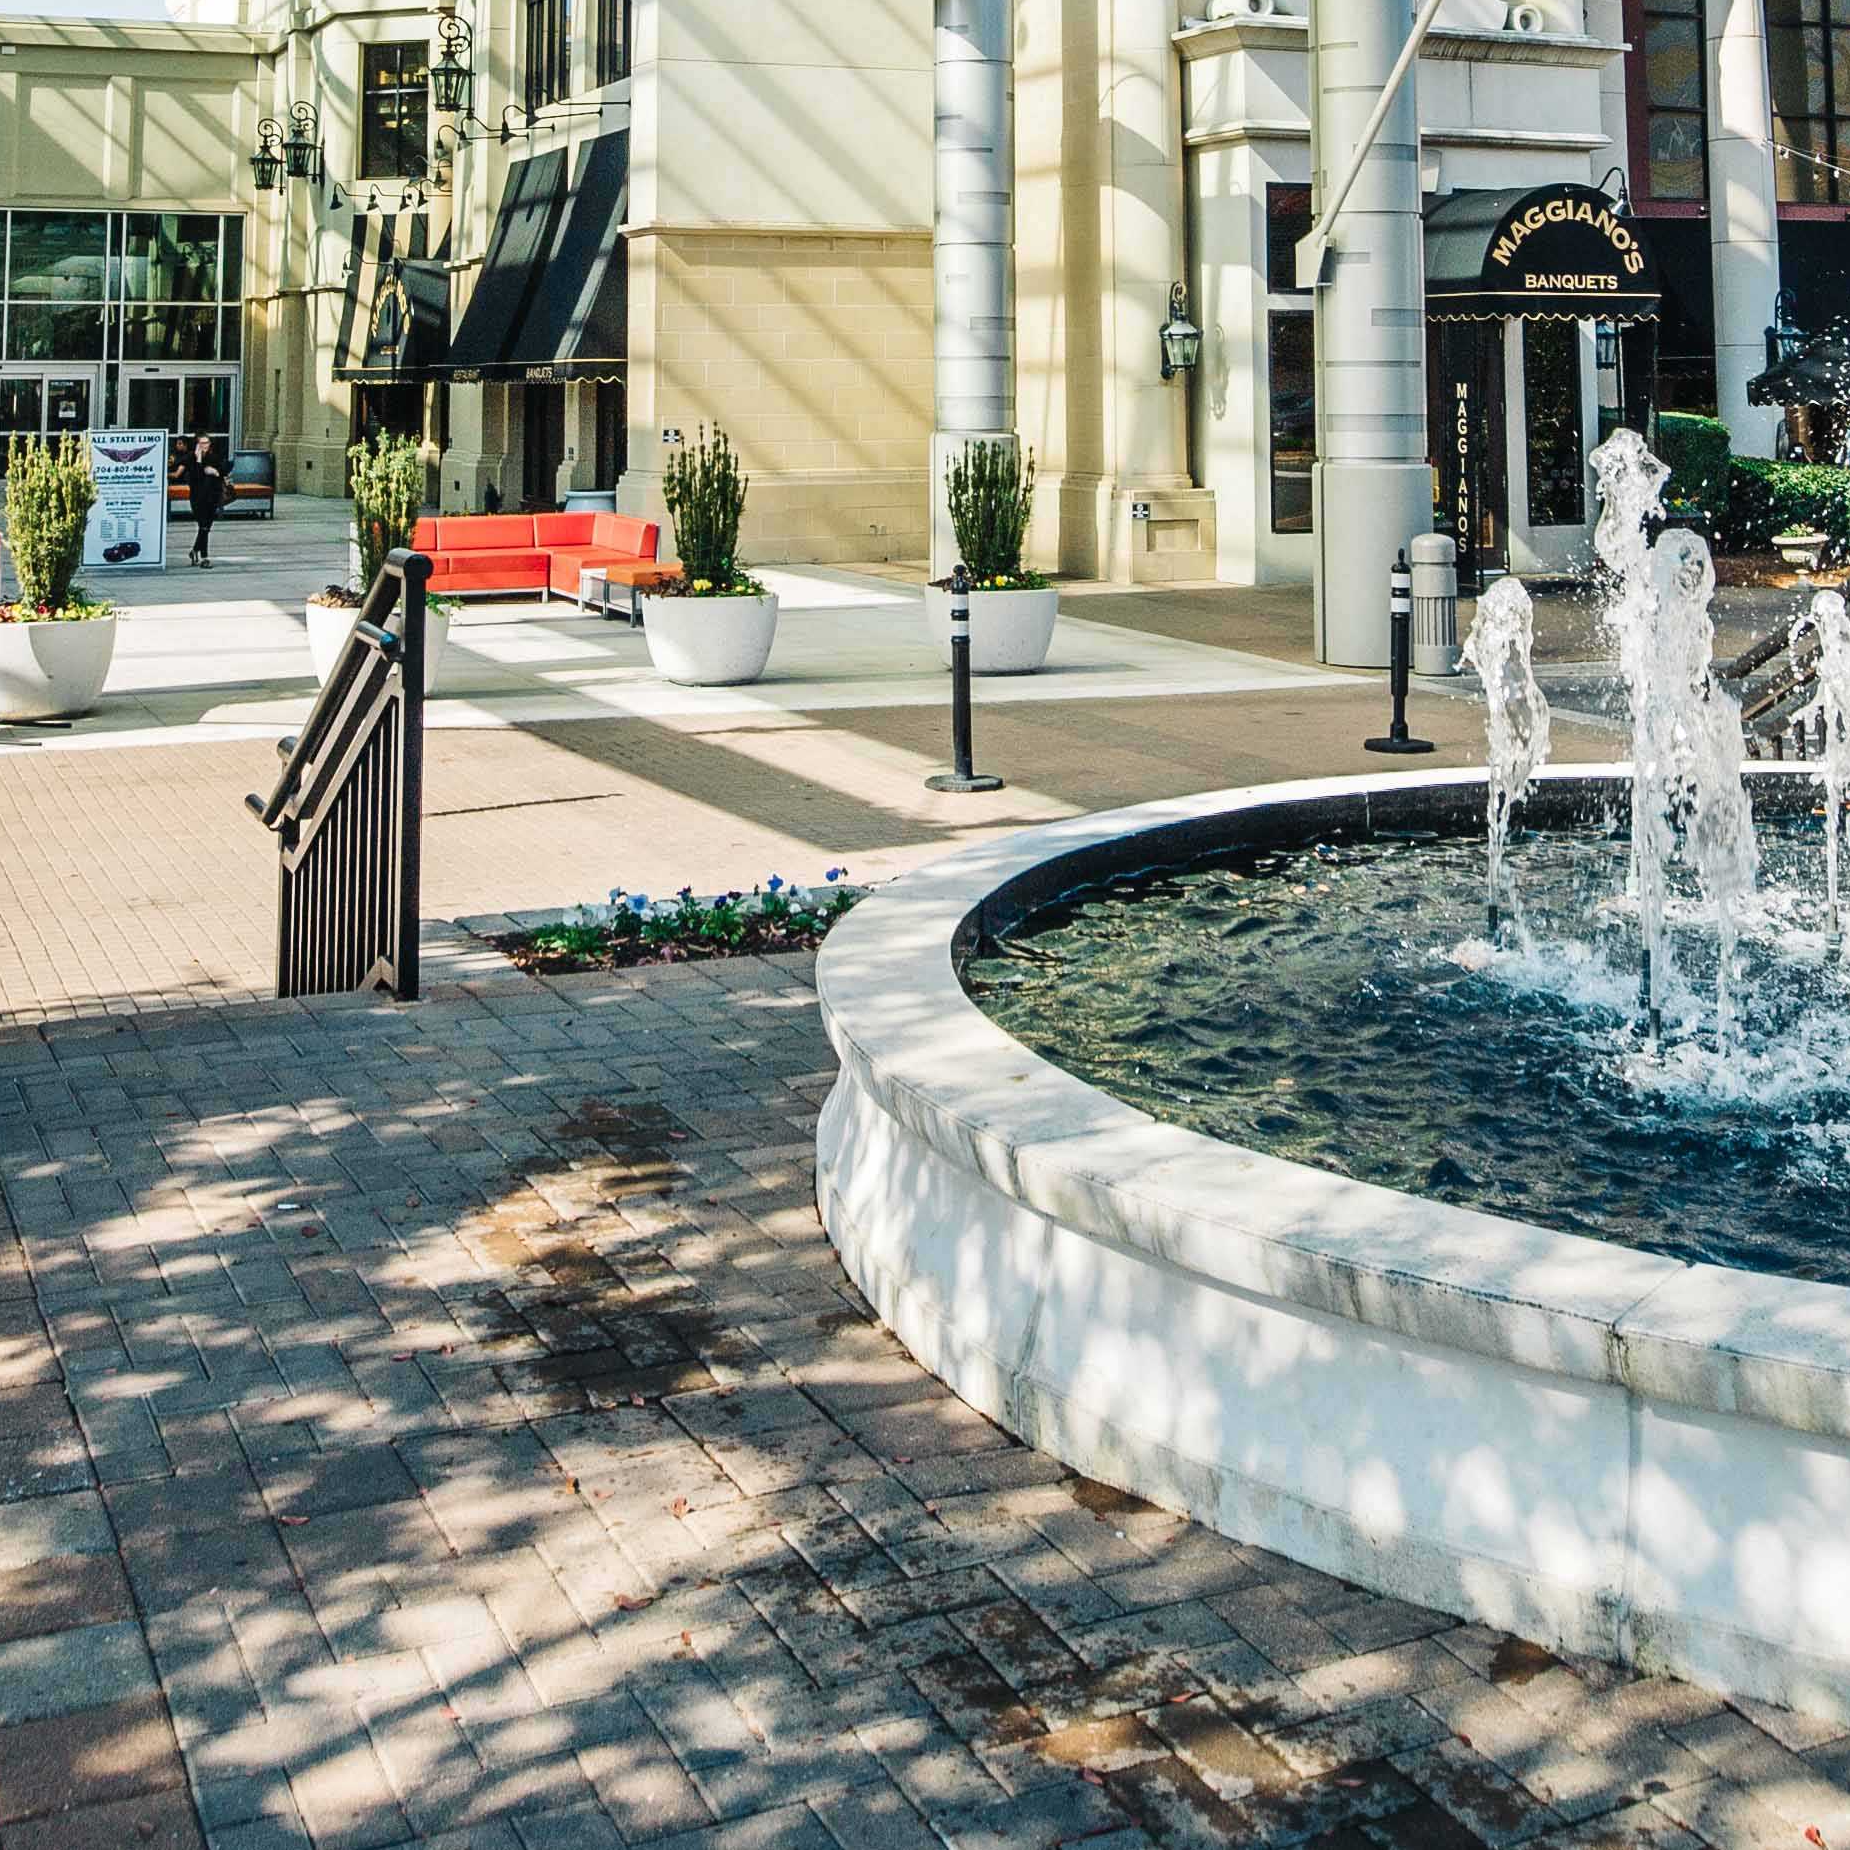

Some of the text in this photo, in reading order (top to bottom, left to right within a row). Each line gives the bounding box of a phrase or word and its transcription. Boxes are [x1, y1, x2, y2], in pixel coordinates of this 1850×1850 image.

[1492, 199, 1644, 275] MAGGIANO'S
[1524, 274, 1618, 290] BANQUETS
[1456, 382, 1469, 553] MAGGIANO'S
